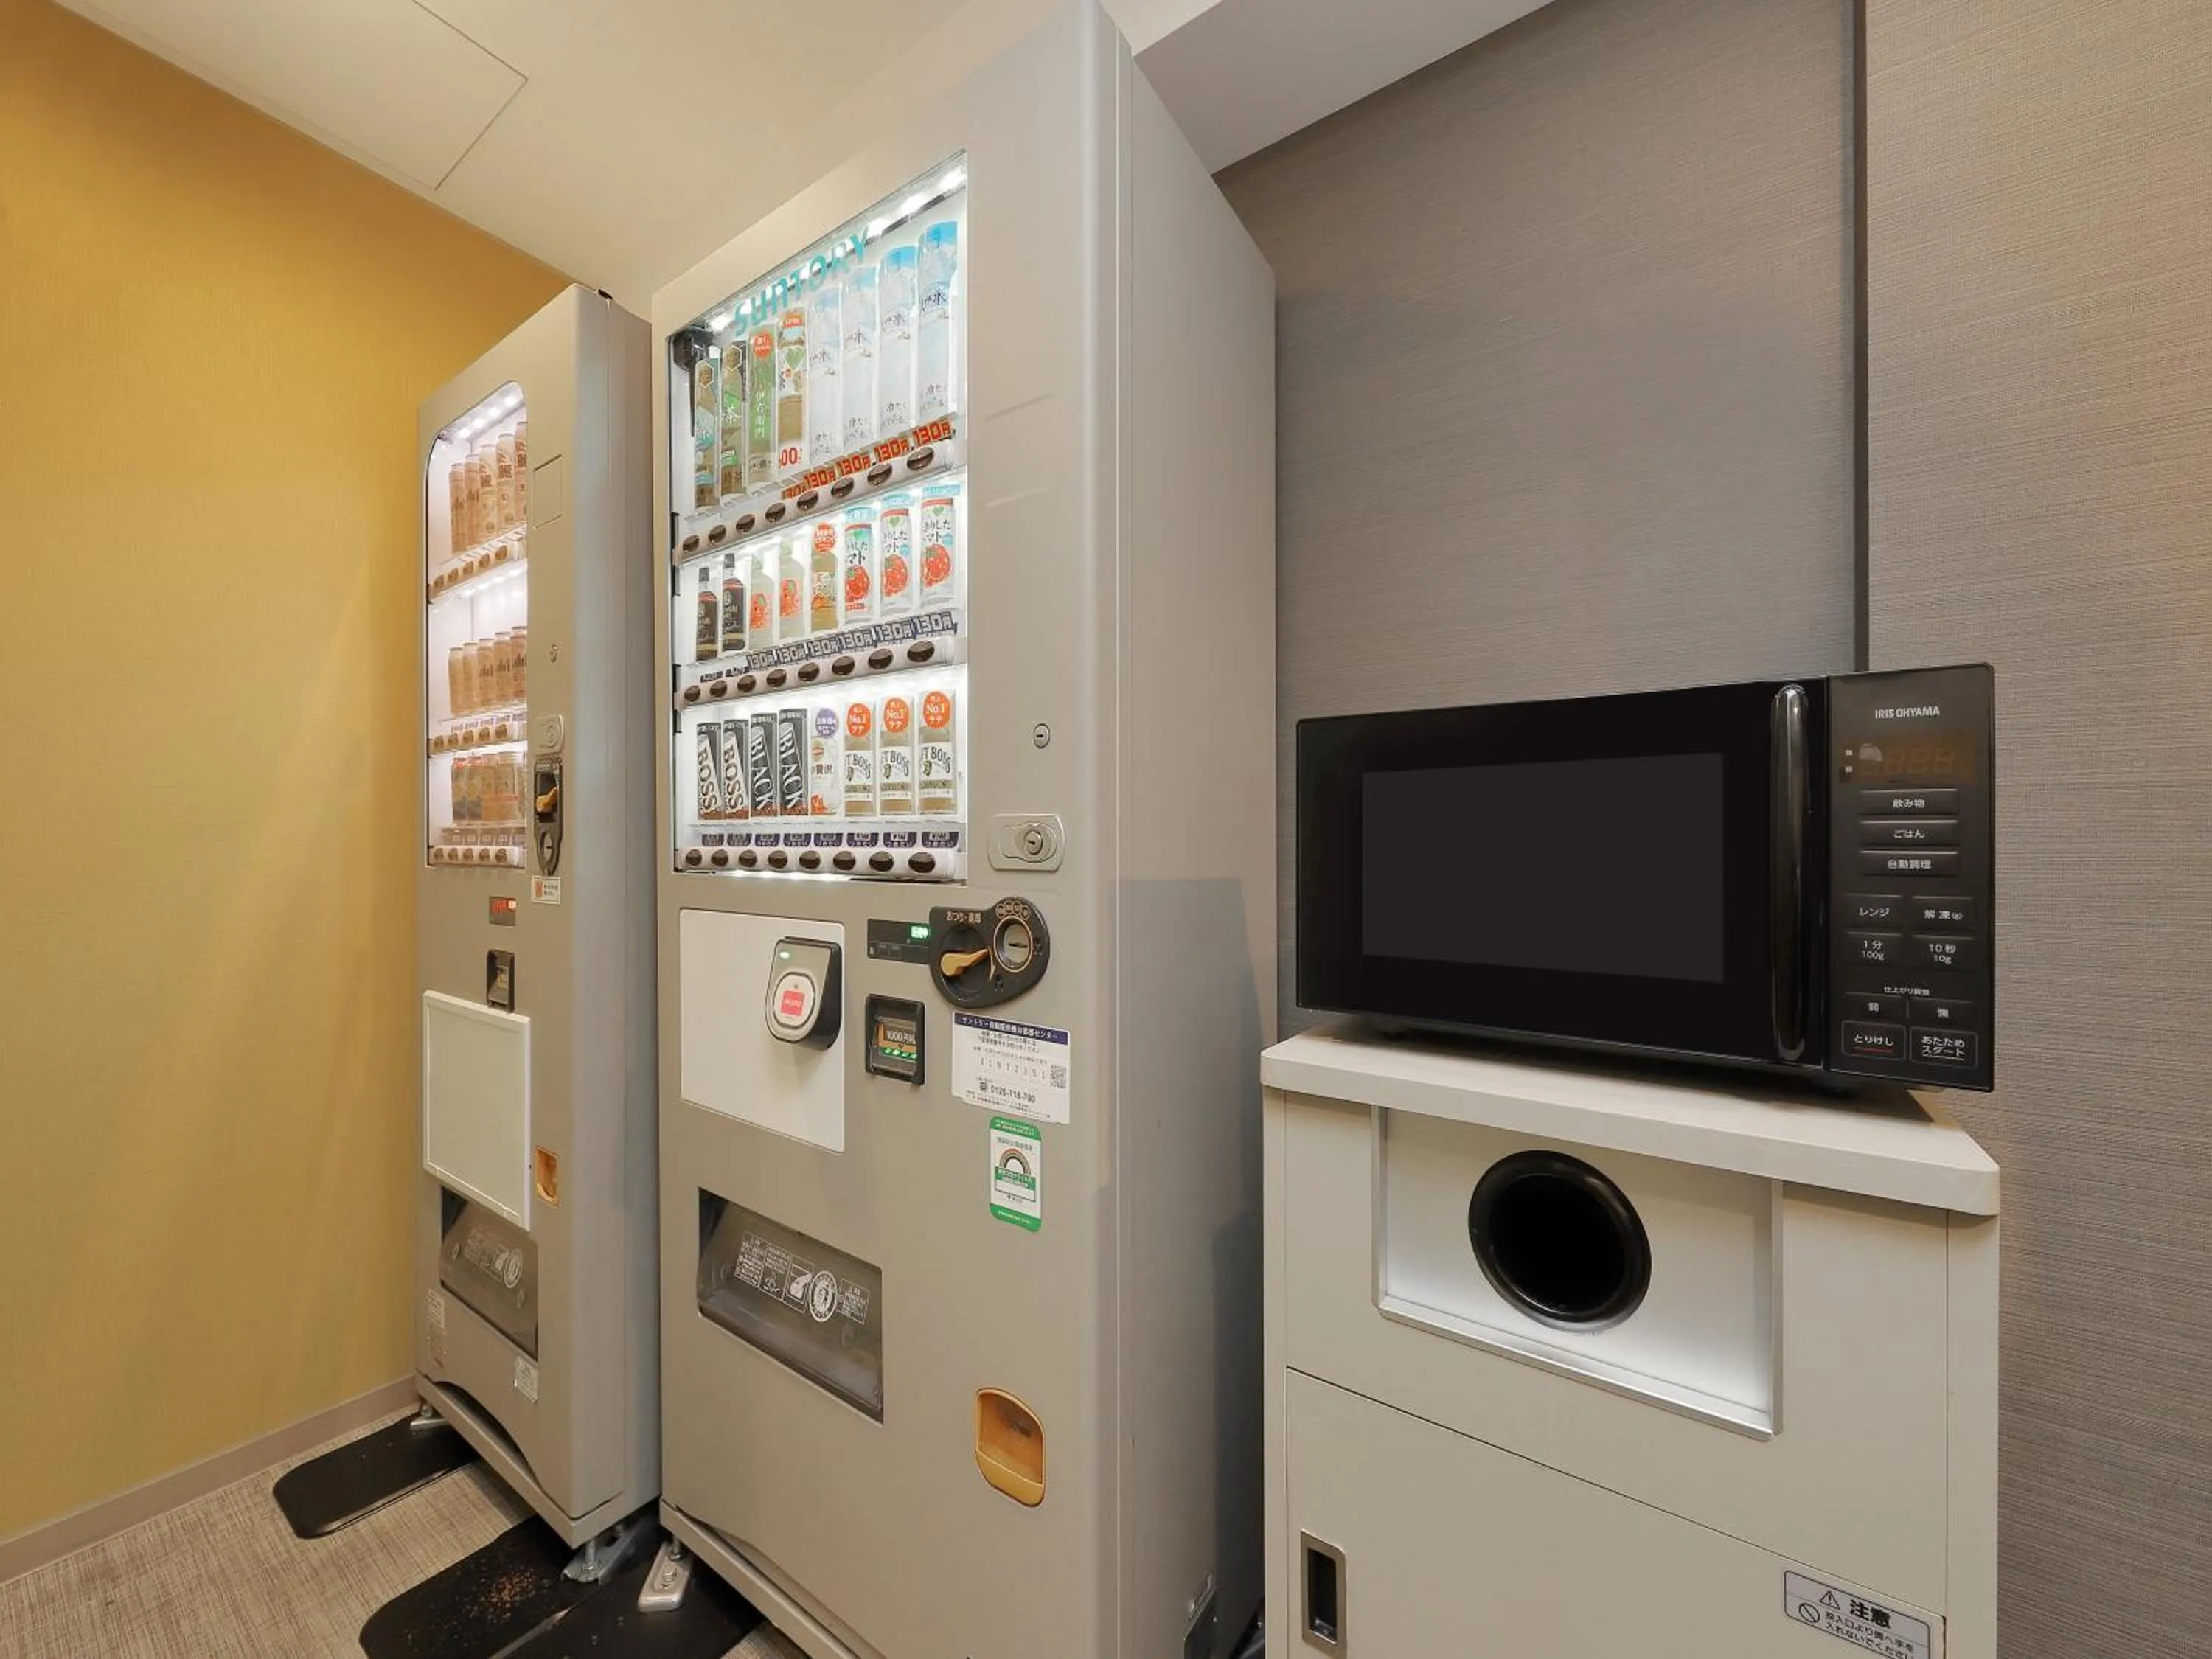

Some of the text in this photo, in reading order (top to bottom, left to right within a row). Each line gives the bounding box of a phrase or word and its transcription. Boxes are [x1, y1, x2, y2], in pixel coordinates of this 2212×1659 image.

[1875, 706, 1941, 719] IRIS OHYAMA
[751, 734, 774, 810] BLACK
[779, 729, 803, 810] BLACK
[698, 746, 717, 810] BOSS
[723, 746, 744, 810] BOSS
[1893, 799, 1925, 808] 飲み物
[1893, 830, 1926, 838] ごはん
[1888, 859, 1931, 869] 自動調理
[1859, 908, 1891, 917] レンジ
[1862, 950, 1885, 961] 100g
[1934, 955, 1952, 964] 10g
[1854, 1034, 1894, 1047] とりけし
[1921, 1035, 1965, 1048] あたため
[1922, 1045, 1965, 1057] スタート
[1849, 1599, 1891, 1629] 注意
